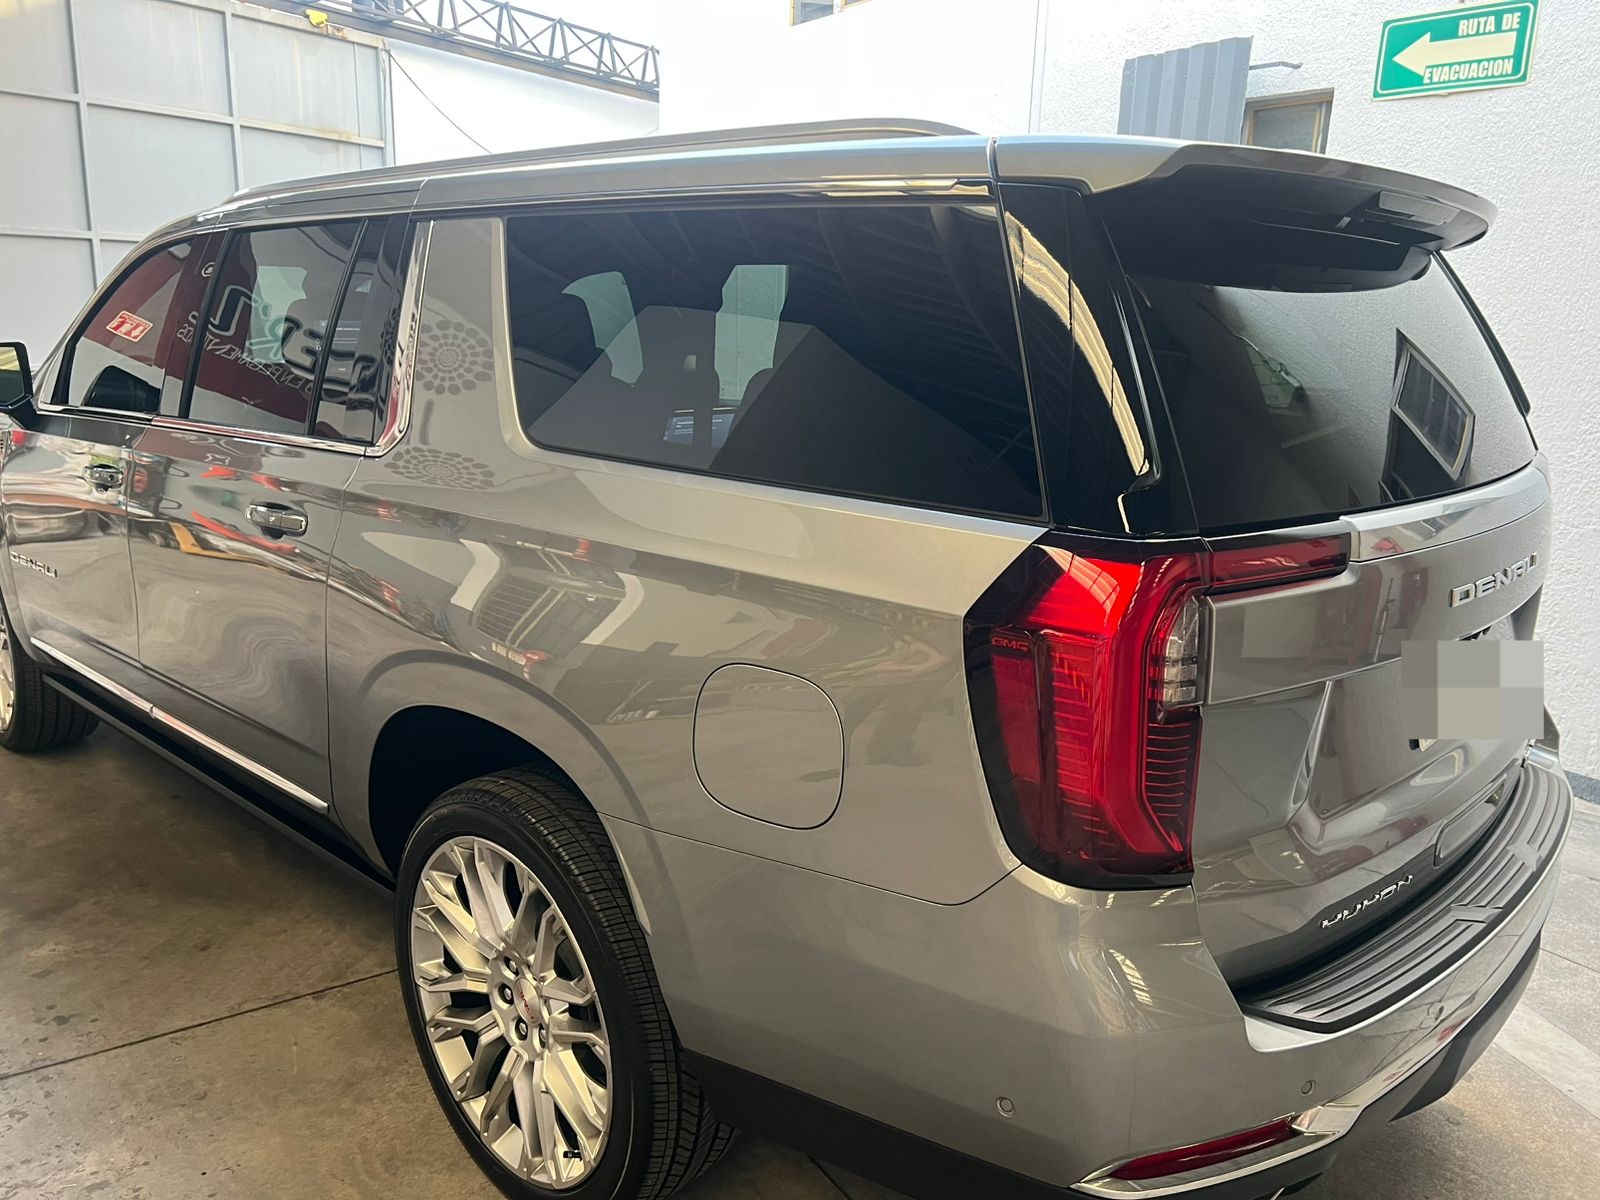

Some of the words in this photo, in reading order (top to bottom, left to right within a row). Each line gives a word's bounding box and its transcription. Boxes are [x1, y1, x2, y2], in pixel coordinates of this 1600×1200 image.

[1458, 16, 1495, 36] RUTA
[1501, 12, 1521, 30] DE
[1423, 58, 1514, 84] EVACUACION
[10, 551, 58, 578] DENALI
[1449, 551, 1538, 608] DENALI
[992, 637, 1029, 652] GMC
